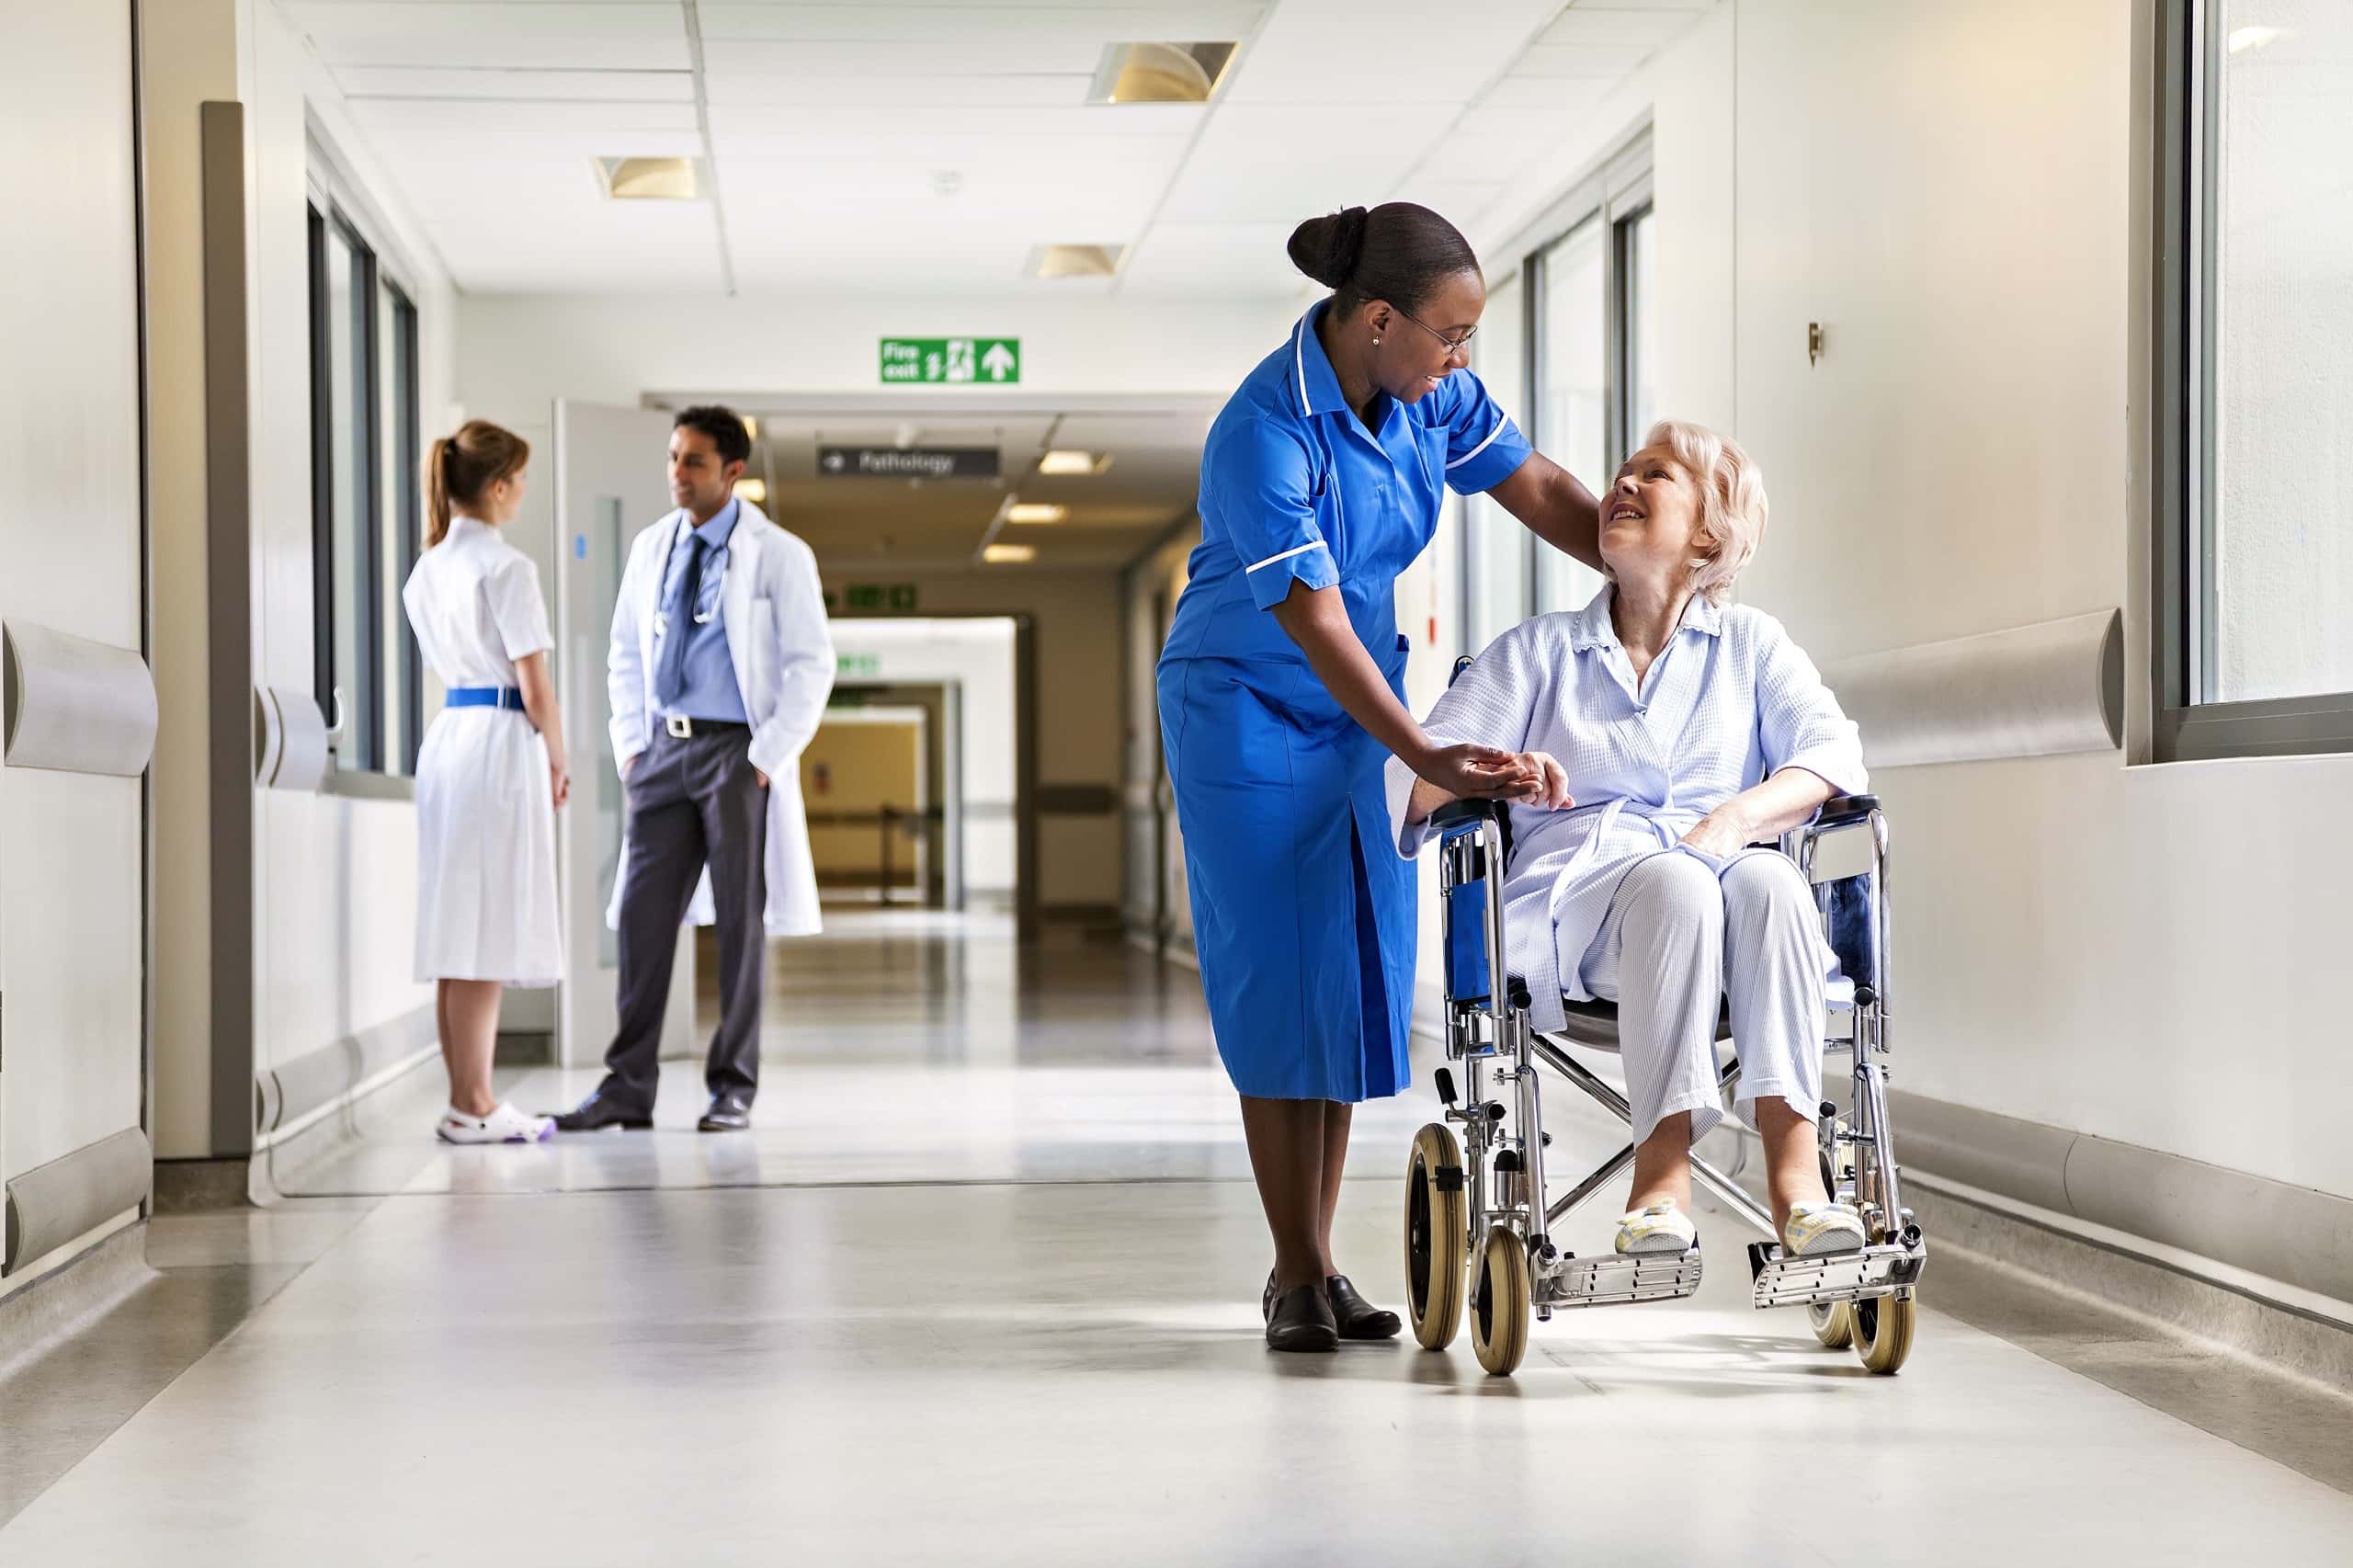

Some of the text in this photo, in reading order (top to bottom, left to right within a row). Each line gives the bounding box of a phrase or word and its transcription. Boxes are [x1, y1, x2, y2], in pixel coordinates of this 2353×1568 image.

[883, 342, 919, 360] Fire
[883, 362, 919, 380] exit
[858, 452, 955, 475] Pathology
